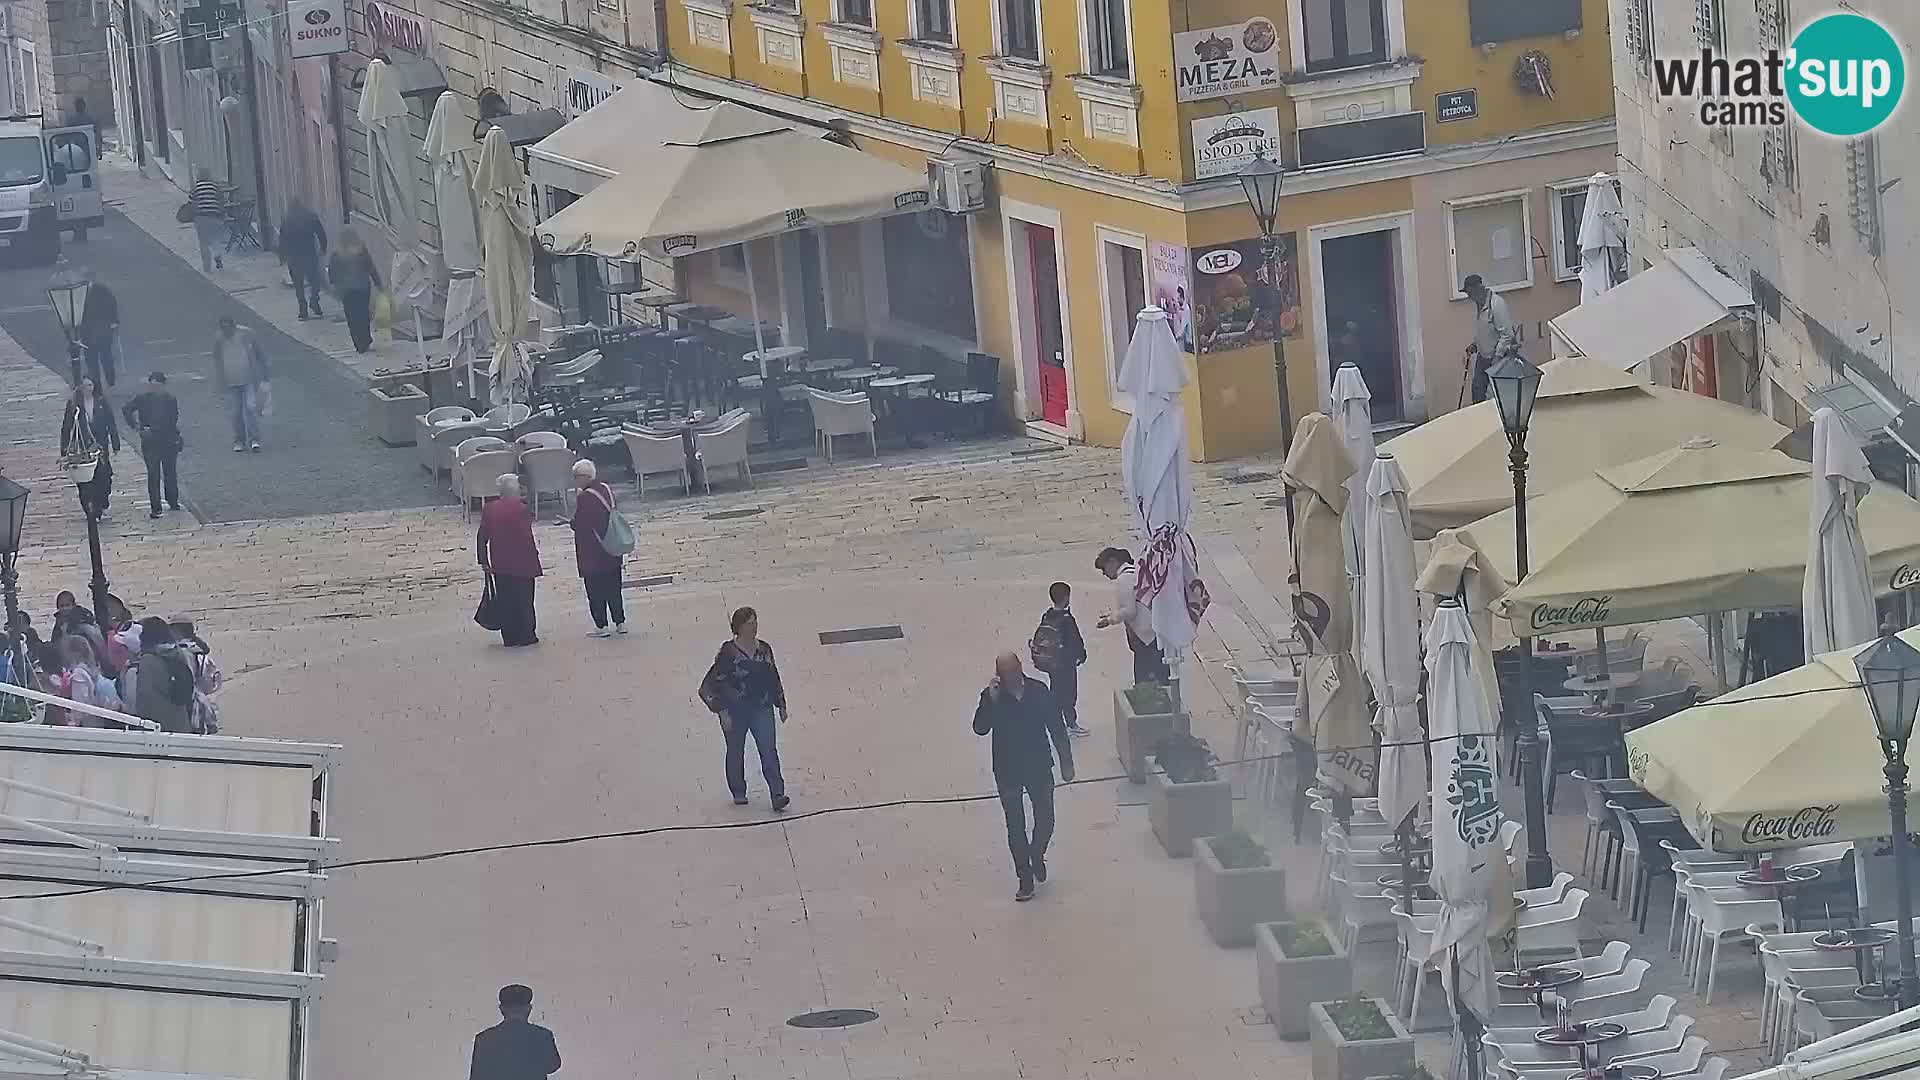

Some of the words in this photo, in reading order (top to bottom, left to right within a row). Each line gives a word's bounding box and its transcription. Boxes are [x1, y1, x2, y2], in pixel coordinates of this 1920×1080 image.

[297, 27, 342, 41] SUKNO
[383, 11, 423, 49] SUKNO
[1180, 57, 1259, 88] MEZA
[1189, 83, 1221, 95] PIZZERIA
[1229, 79, 1250, 90] GRILL
[1198, 142, 1244, 161] ISPOD
